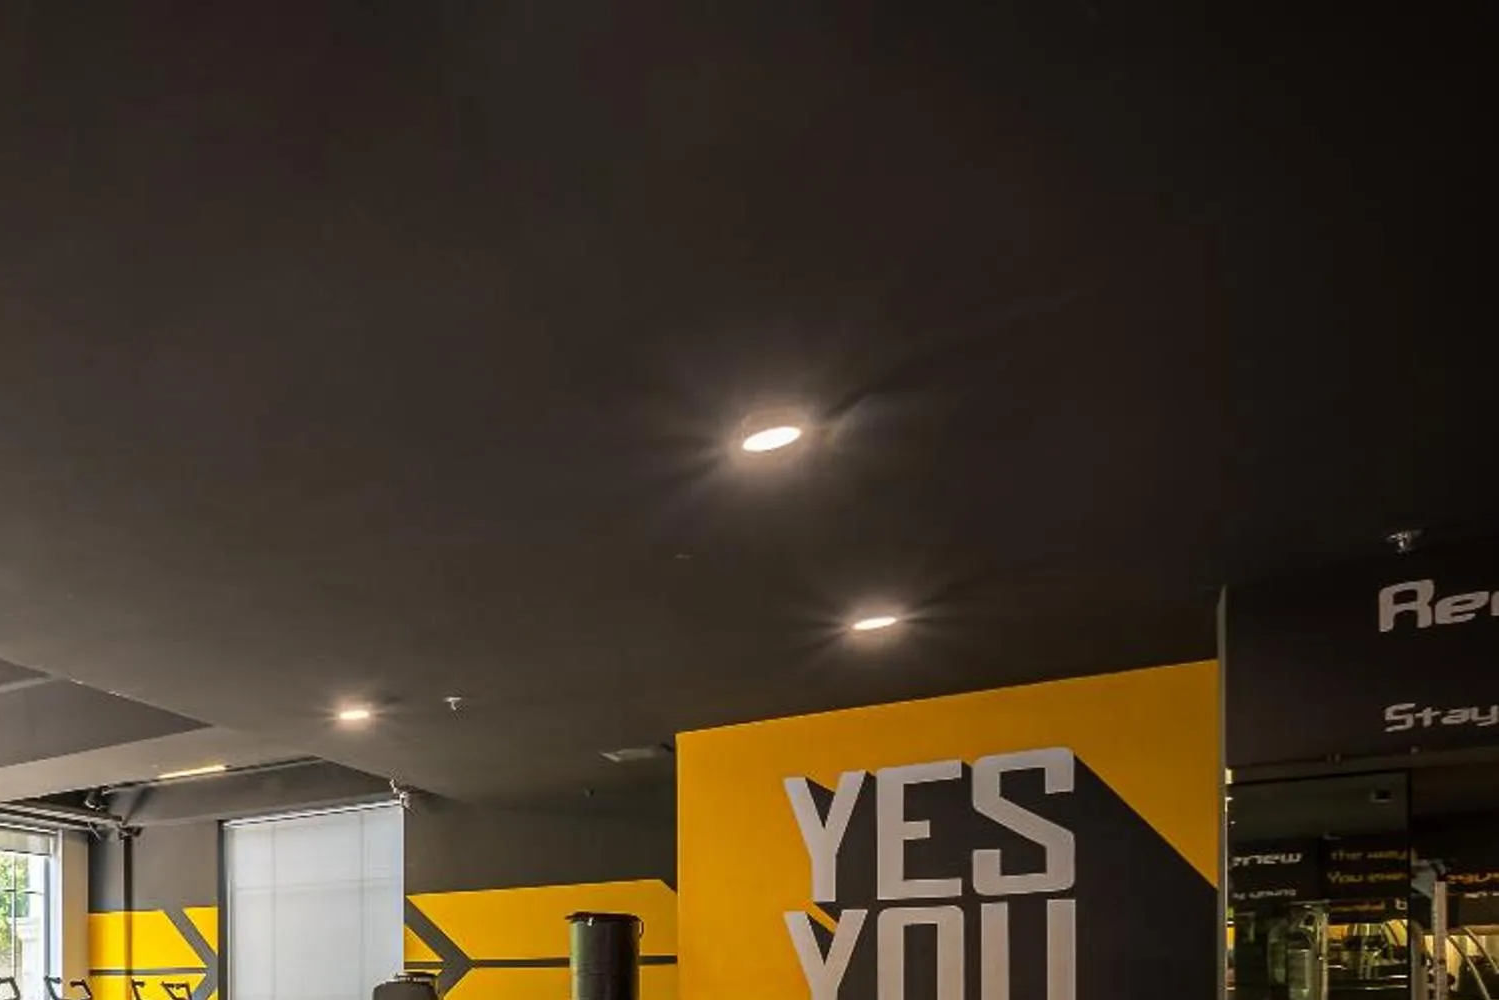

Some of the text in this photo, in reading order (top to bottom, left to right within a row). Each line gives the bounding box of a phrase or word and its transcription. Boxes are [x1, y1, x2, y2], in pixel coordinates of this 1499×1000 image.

[1379, 578, 1499, 633] Re
[1384, 702, 1499, 733] Stay
[784, 747, 1076, 902] YES
